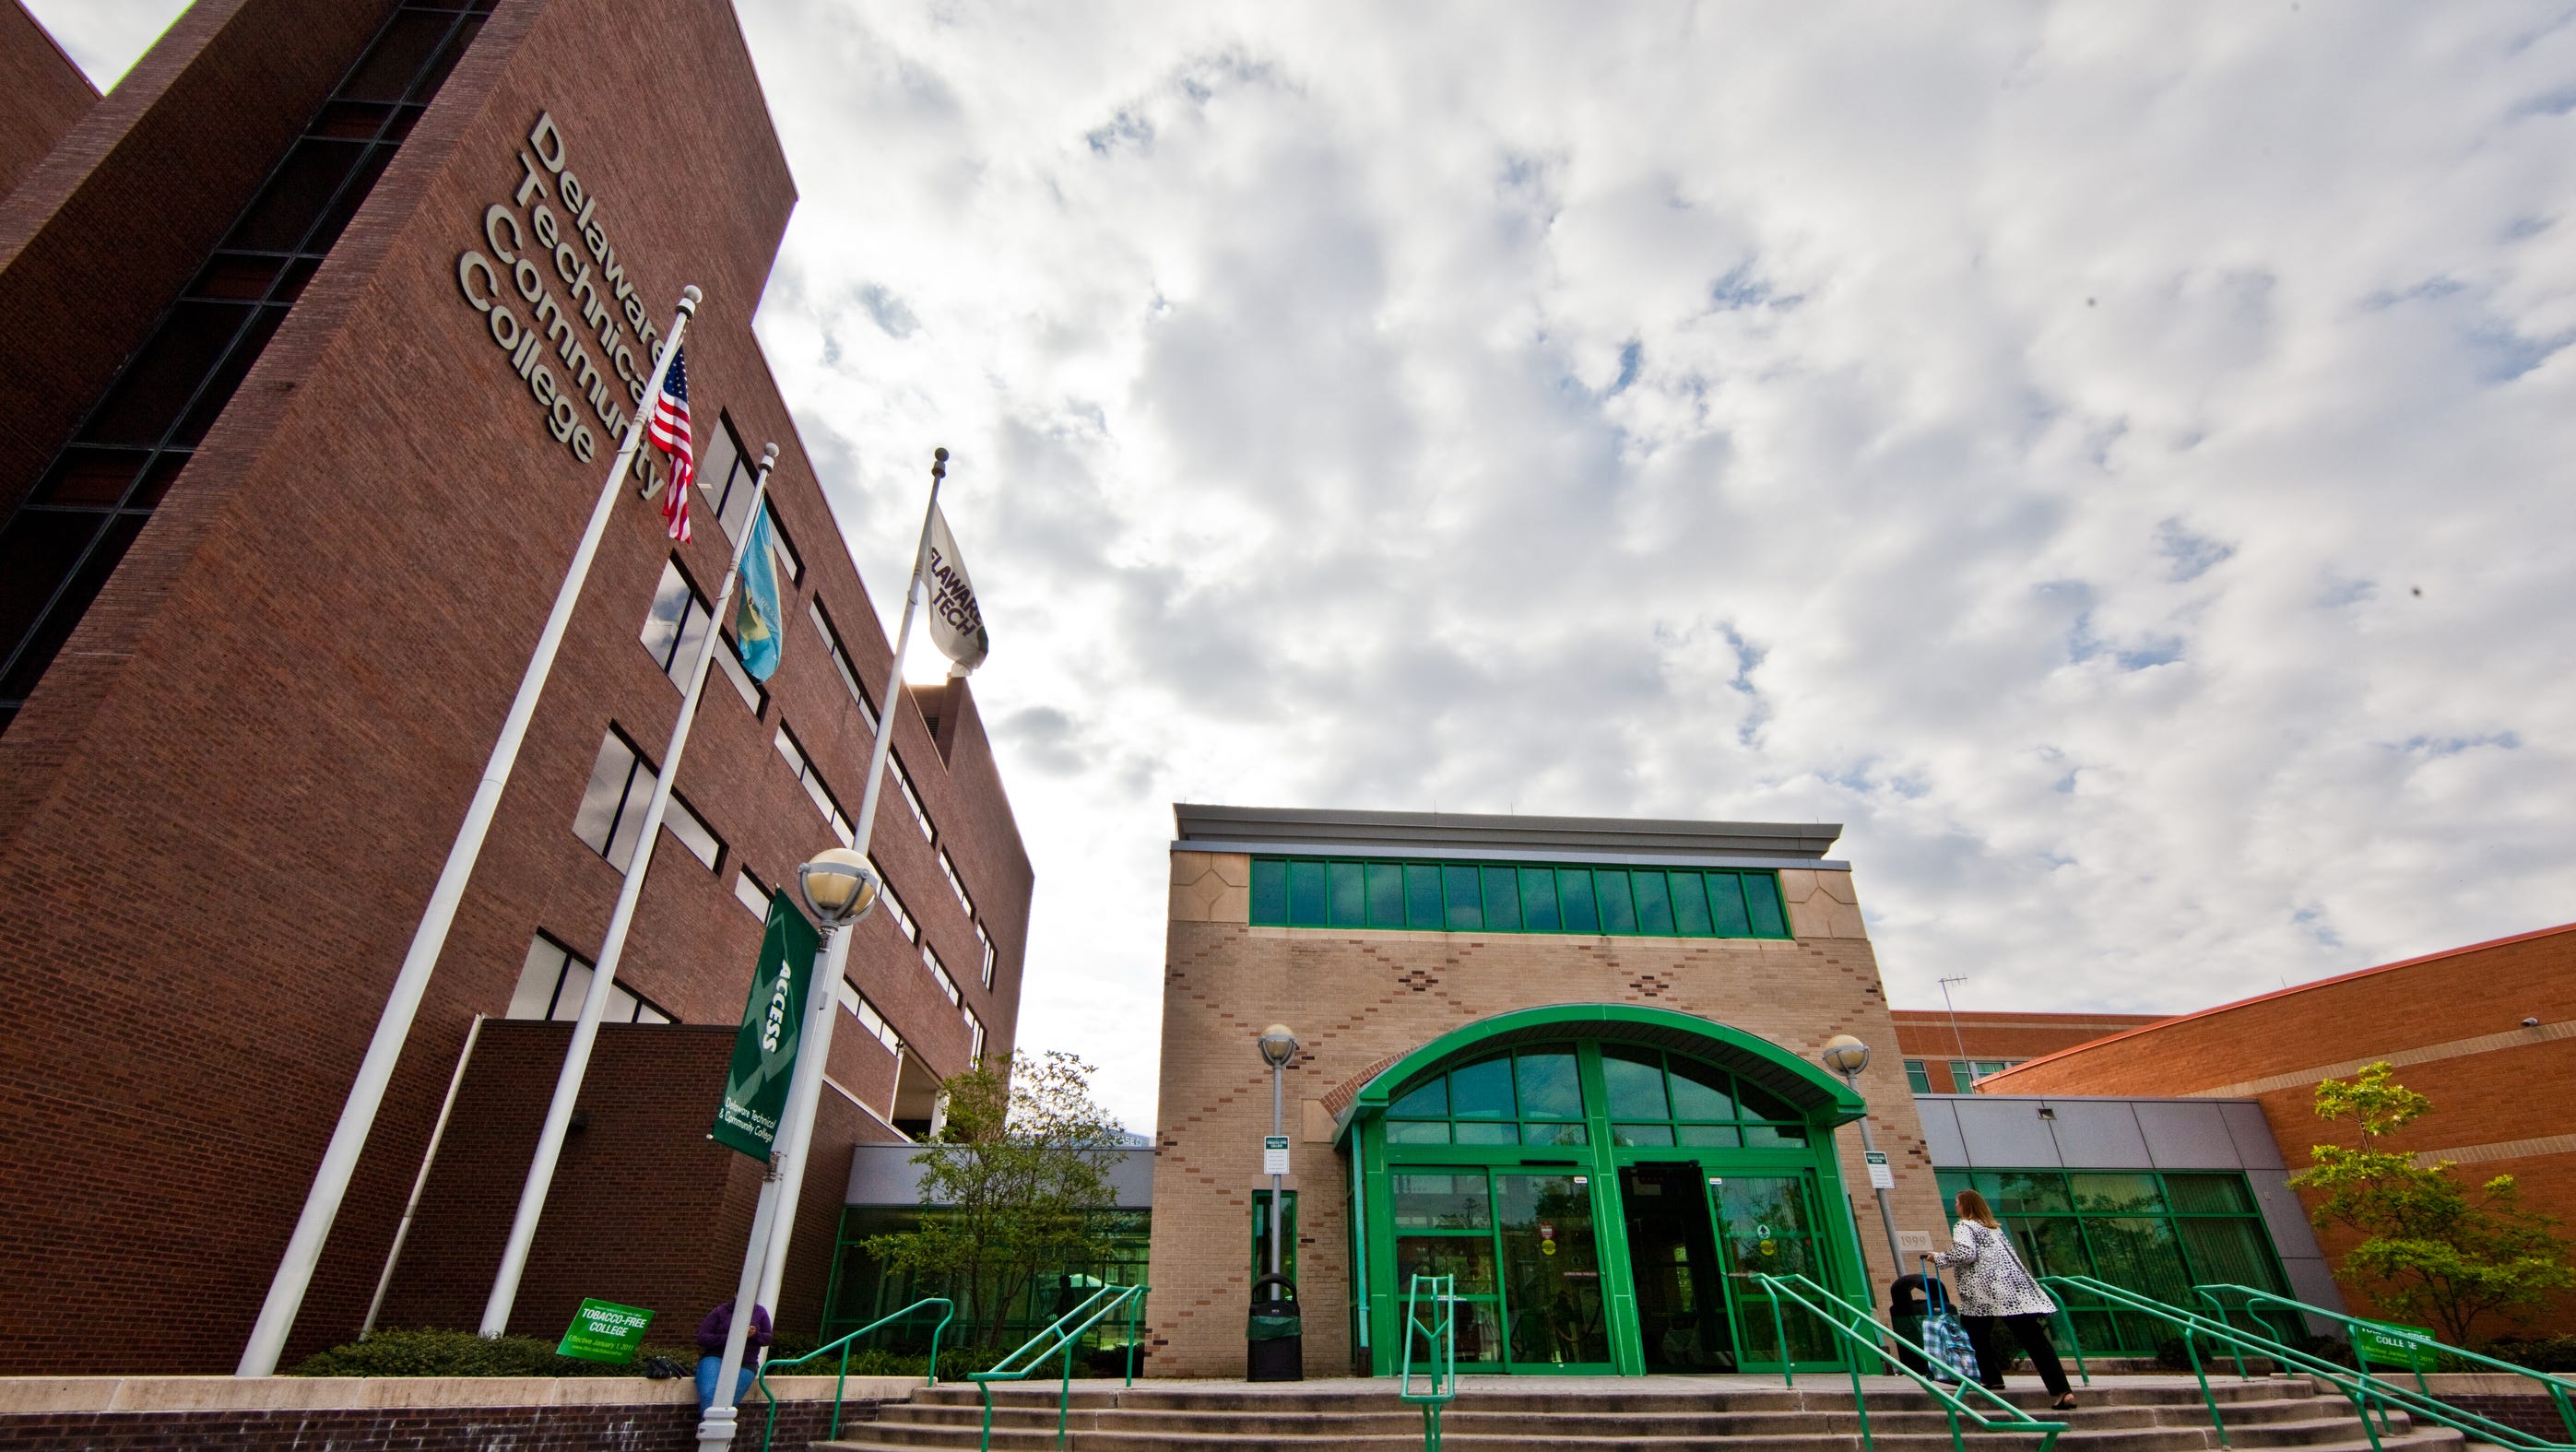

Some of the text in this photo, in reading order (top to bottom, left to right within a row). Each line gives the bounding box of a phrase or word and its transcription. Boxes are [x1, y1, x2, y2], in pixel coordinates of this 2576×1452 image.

[527, 110, 665, 371] Delaware
[514, 151, 671, 462] Technica
[458, 249, 596, 465] College
[483, 203, 665, 501] Communty
[933, 586, 977, 637] TECH
[762, 959, 791, 1054] ACCESS
[718, 1107, 774, 1143] & Community College
[725, 1096, 777, 1130] Delaware Technical
[1901, 1236, 1925, 1247] 1999
[582, 1307, 647, 1328] TOBACCO-FREE
[589, 1321, 629, 1337] COLLEGE
[568, 1335, 592, 1344] Effective
[592, 1340, 615, 1350] January
